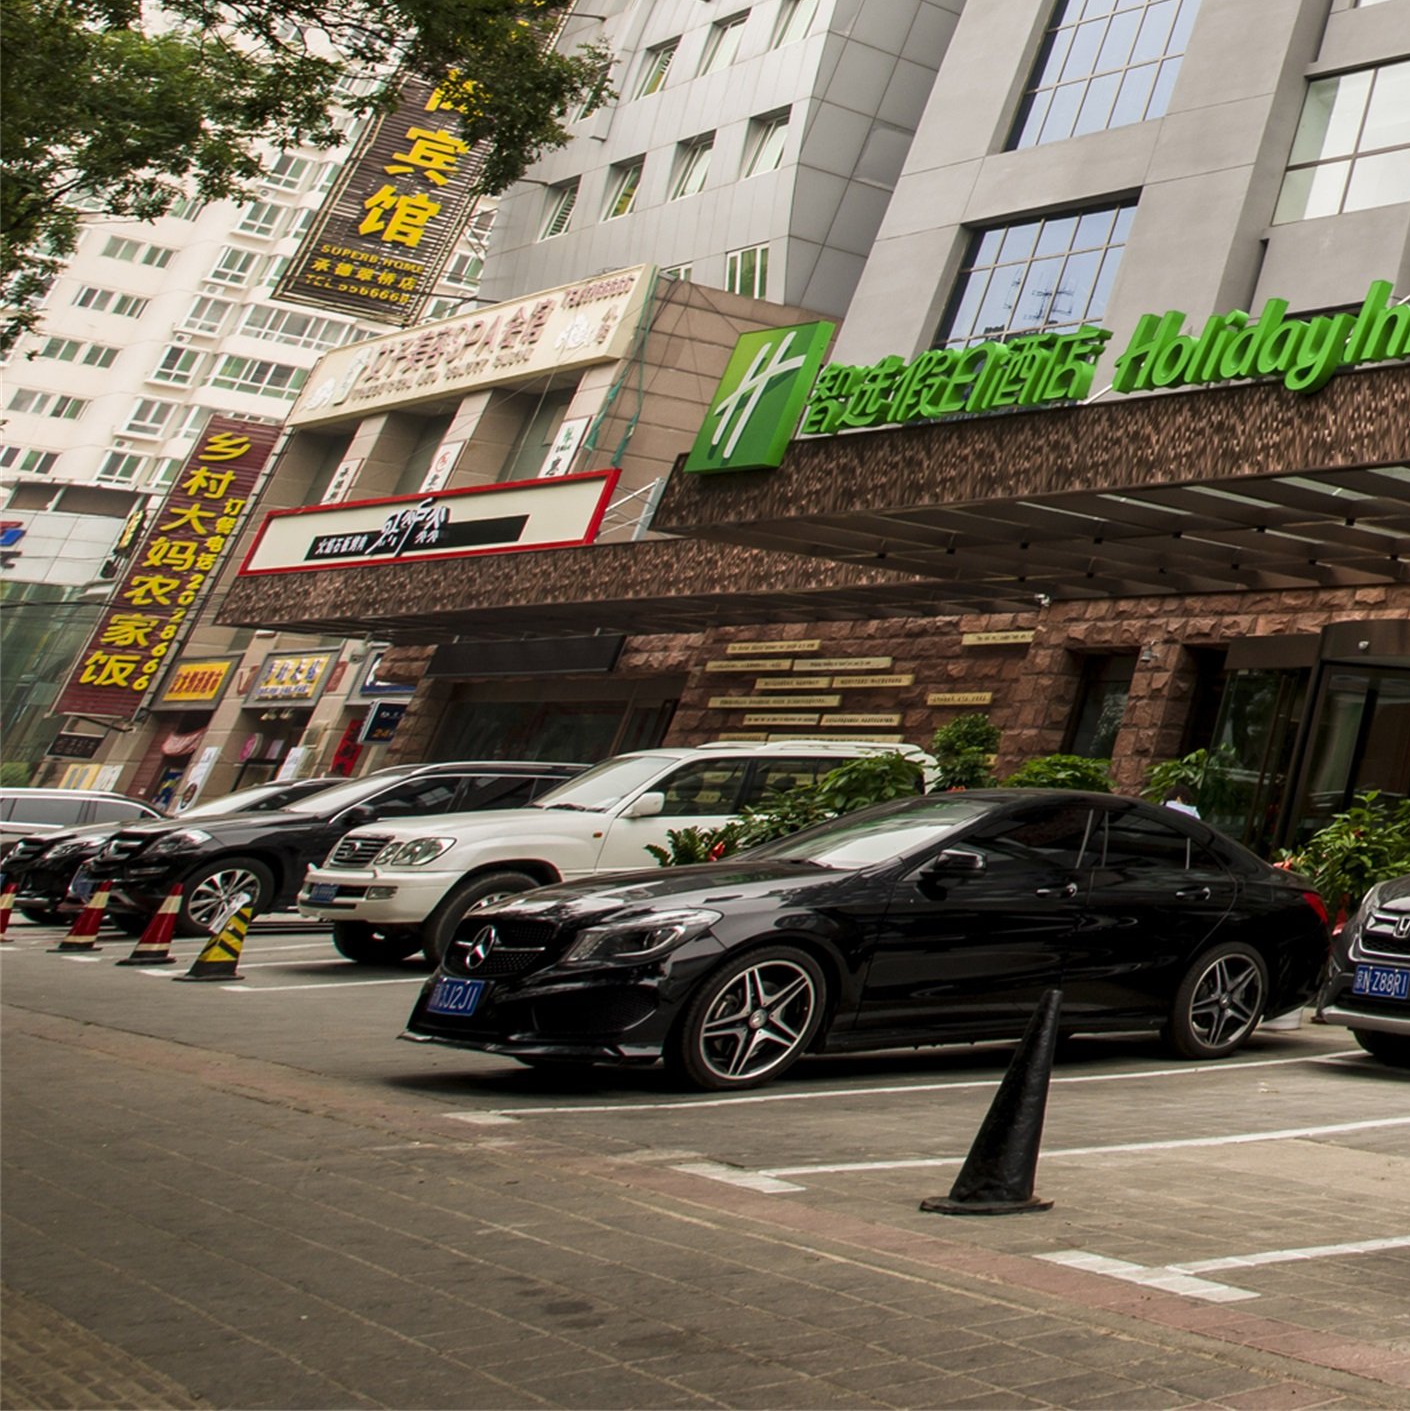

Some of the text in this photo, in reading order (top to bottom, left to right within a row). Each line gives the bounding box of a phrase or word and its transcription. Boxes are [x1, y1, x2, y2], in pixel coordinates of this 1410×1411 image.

[320, 244, 378, 264] SUPERB
[800, 329, 1112, 435] 智选假日酒店
[1112, 297, 1357, 394] Holiday
[78, 432, 251, 687] 乡村大妈农家饭
